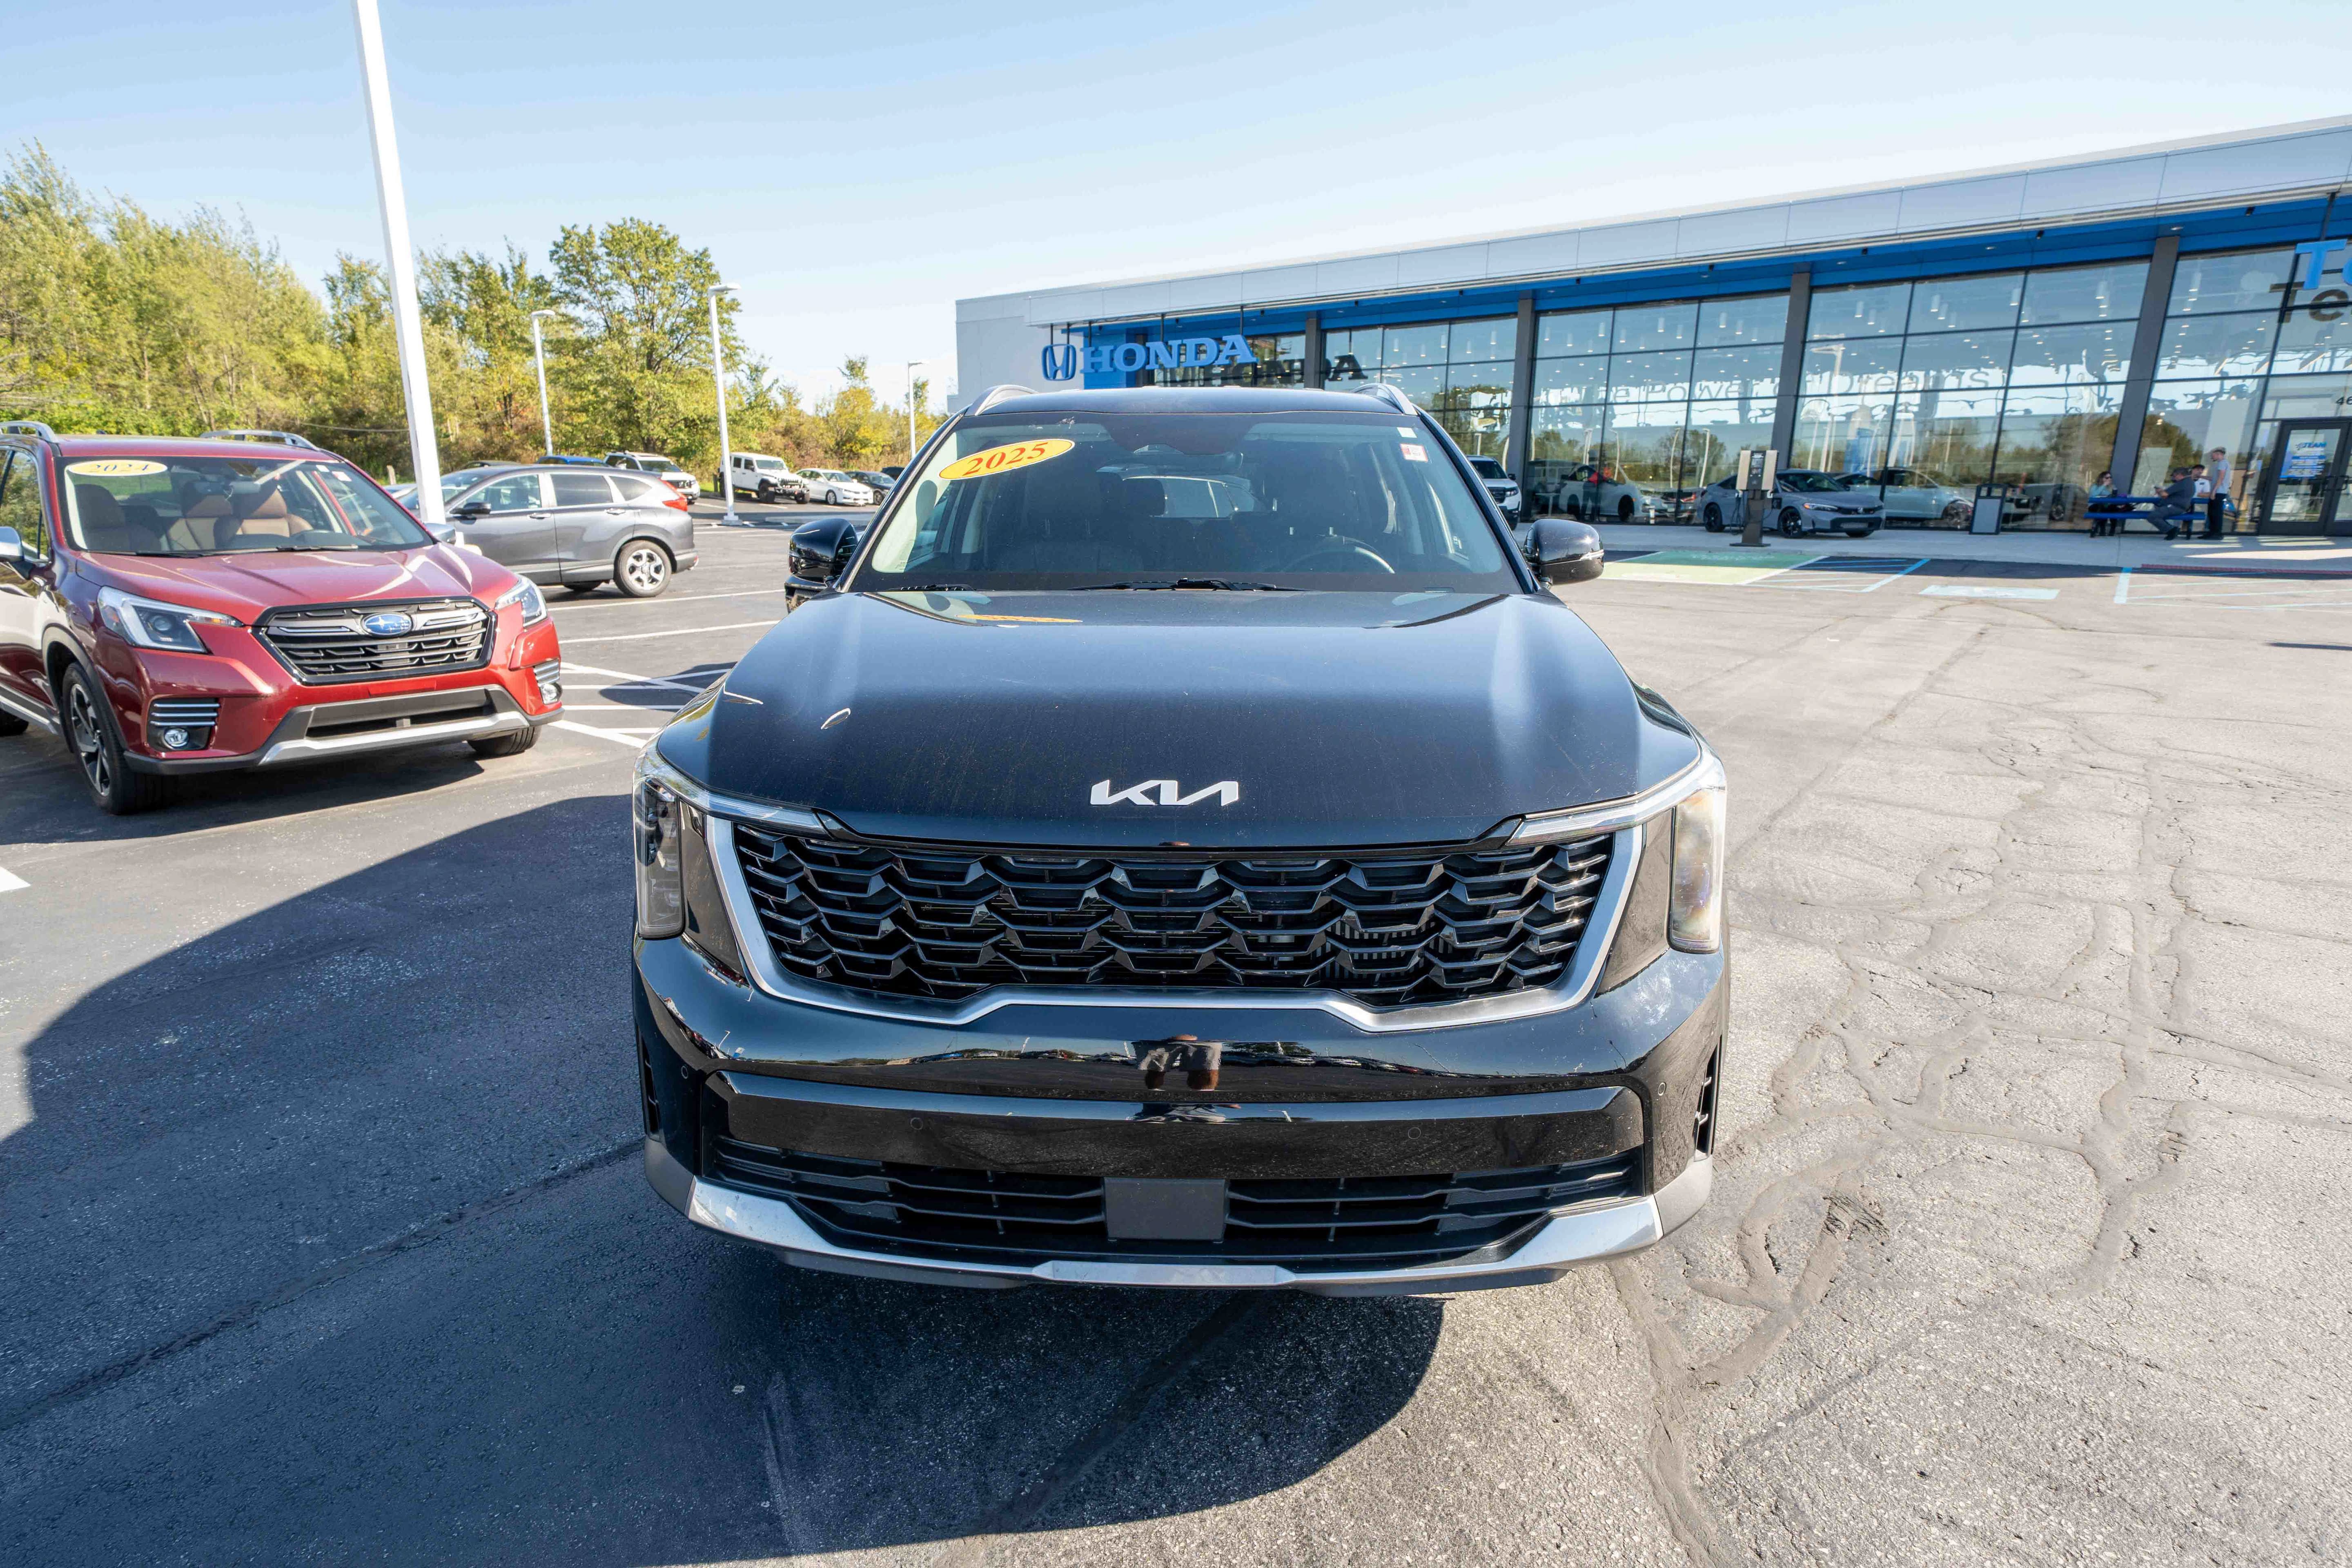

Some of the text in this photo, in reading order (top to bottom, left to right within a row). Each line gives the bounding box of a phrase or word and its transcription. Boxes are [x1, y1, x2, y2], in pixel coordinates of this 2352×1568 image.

[1080, 334, 1259, 373] HONDA
[87, 463, 150, 473] 2024
[961, 442, 1049, 477] 2025
[1090, 779, 1239, 806] KIA
